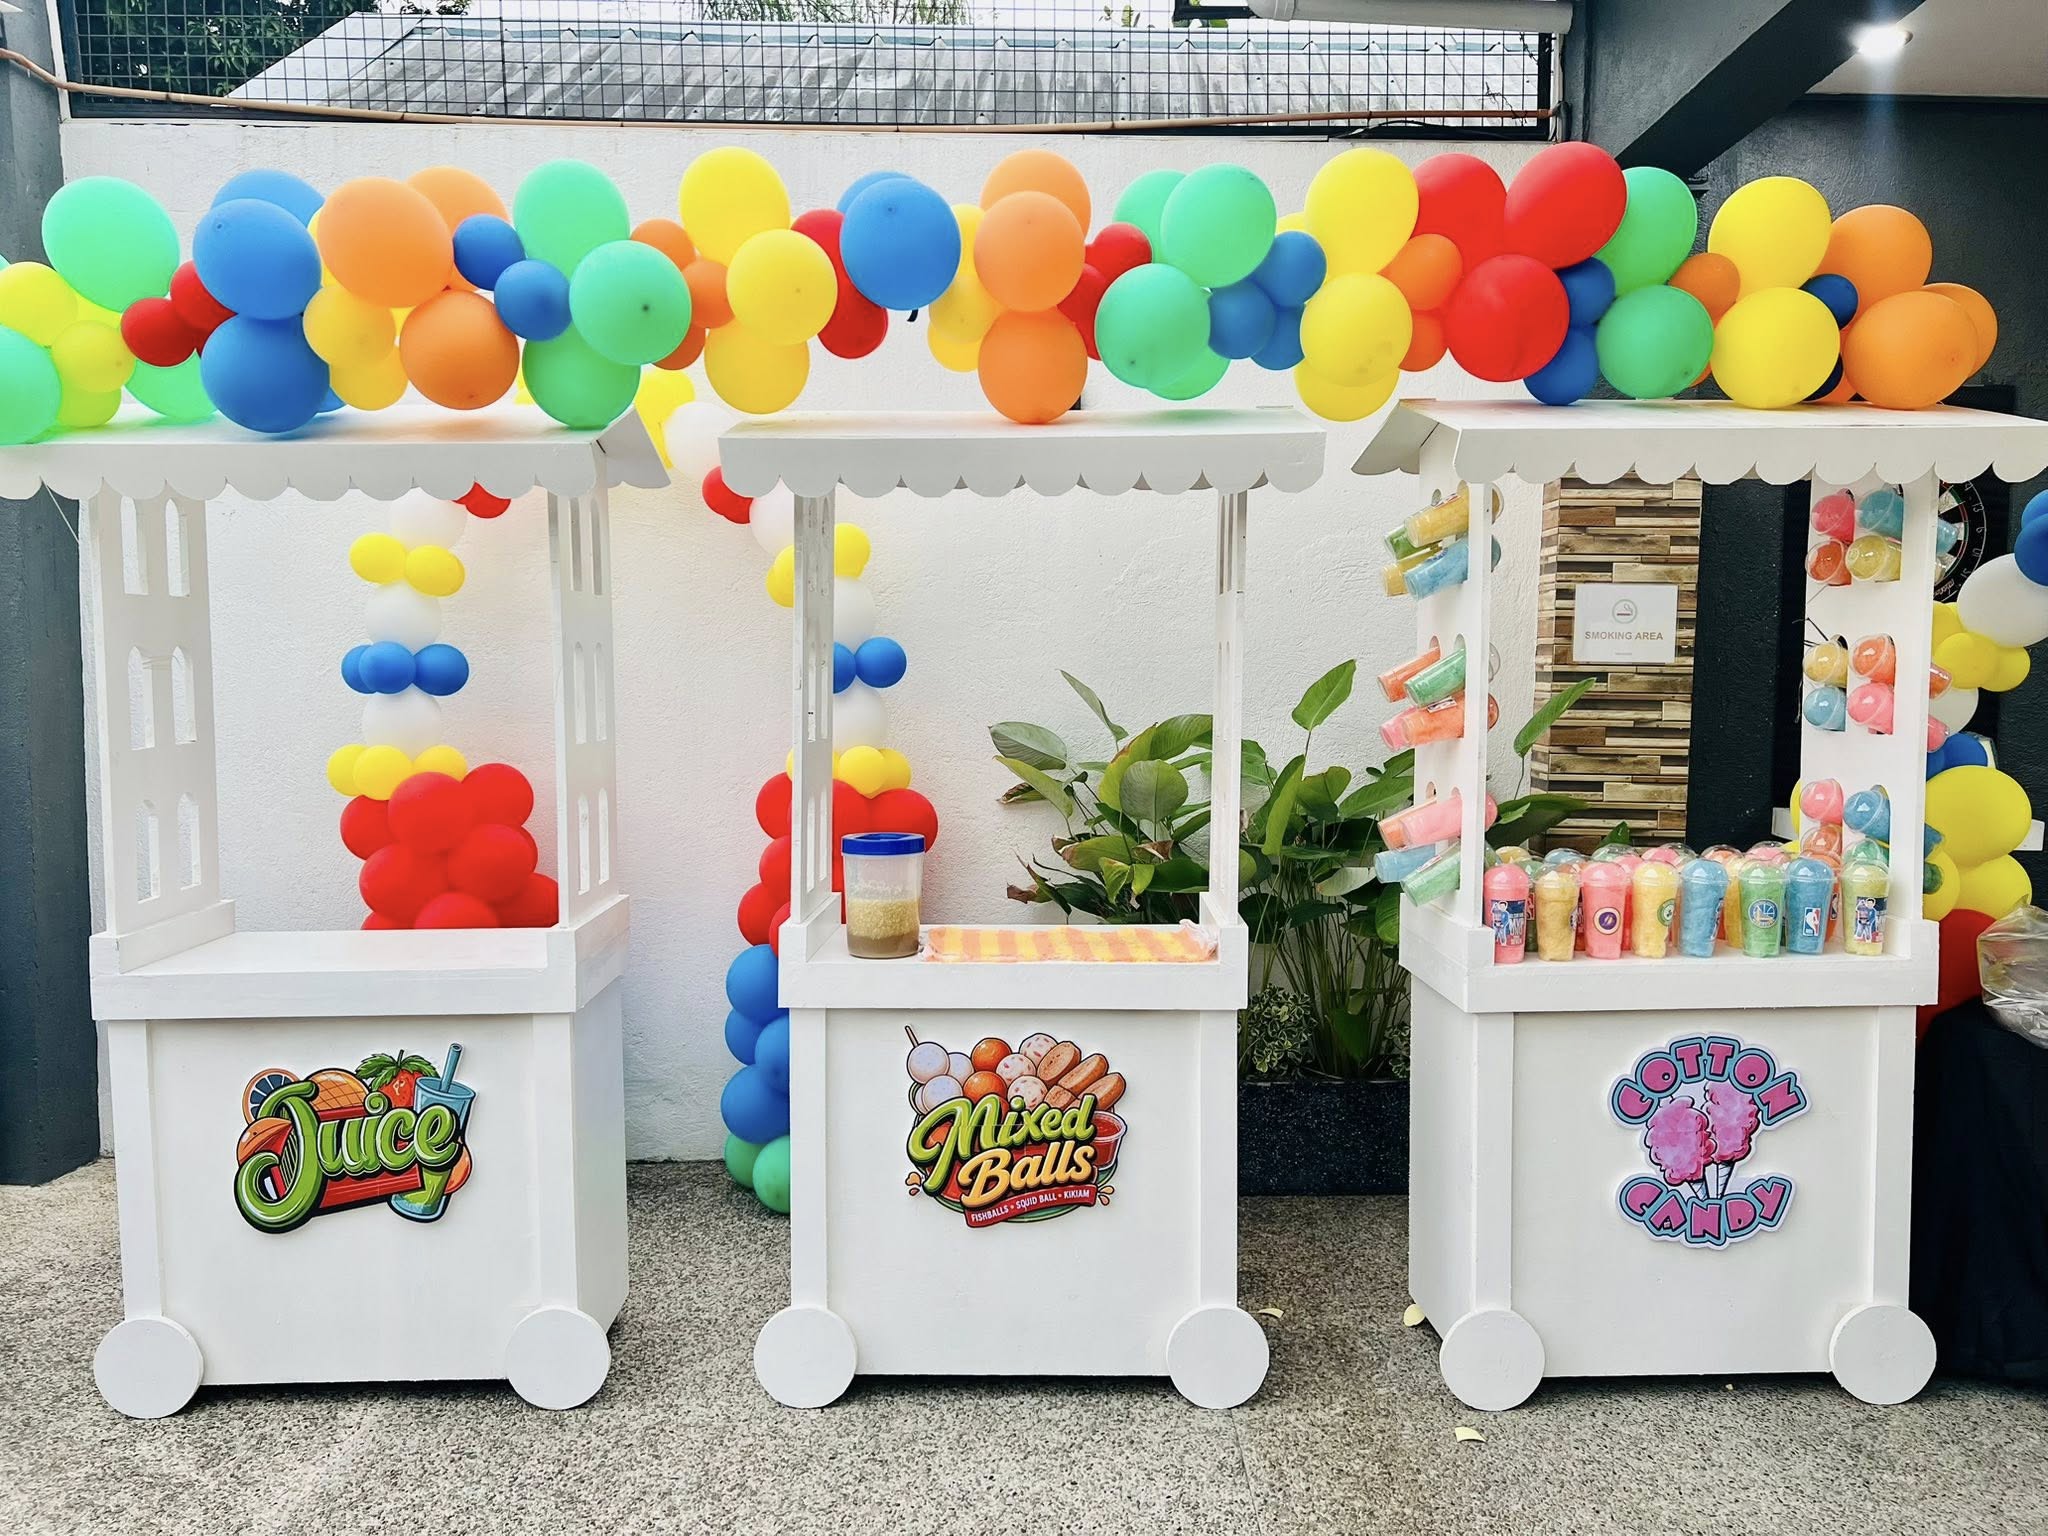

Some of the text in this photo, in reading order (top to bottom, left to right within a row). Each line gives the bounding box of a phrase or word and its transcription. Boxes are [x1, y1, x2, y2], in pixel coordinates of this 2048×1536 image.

[1972, 502, 1984, 512] 13
[1976, 526, 1985, 534] 6
[1584, 631, 1664, 640] SMOKING AREA
[1616, 1041, 1801, 1121] COTTON
[236, 1080, 460, 1229] Juice
[908, 1093, 1096, 1192] Mixed
[958, 1140, 1096, 1207] Balls
[970, 1188, 1090, 1222] FISHBALLS SQUID BALL KIKIAM
[1624, 1180, 1787, 1239] CANDY
